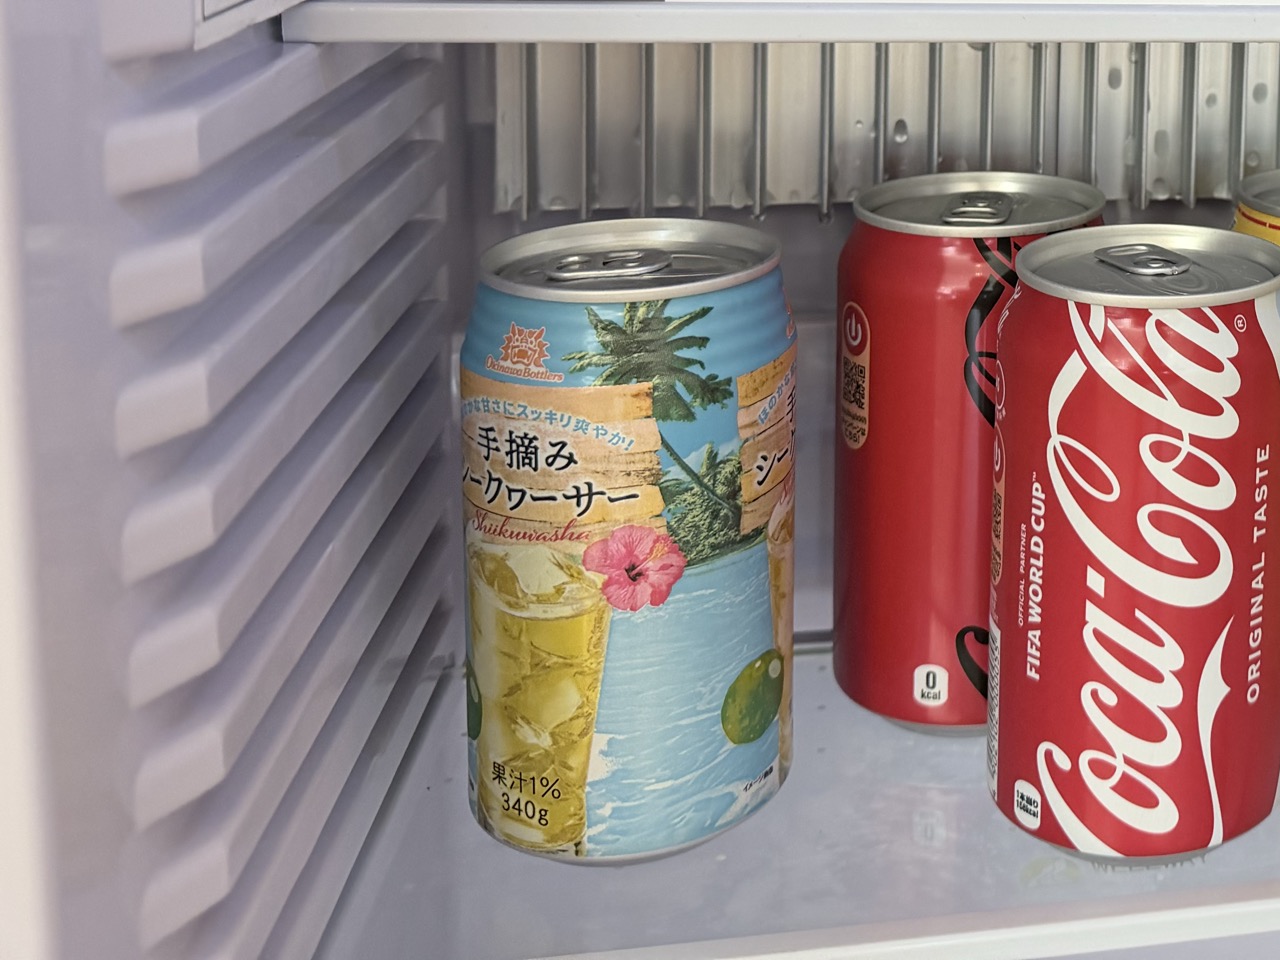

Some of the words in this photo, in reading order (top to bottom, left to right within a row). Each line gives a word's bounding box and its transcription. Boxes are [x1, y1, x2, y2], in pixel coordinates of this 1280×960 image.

[477, 425, 579, 473] 手摘み
[1253, 445, 1270, 543] TASTE
[1019, 523, 1027, 574] PARTNER
[1028, 535, 1045, 623] WORLD
[1247, 551, 1265, 705] ORIGINAL
[1026, 629, 1041, 681] FIFA
[920, 688, 941, 702] kcal
[925, 670, 937, 690] 0
[491, 761, 563, 800] 果汁1%
[501, 792, 550, 827] 340g
